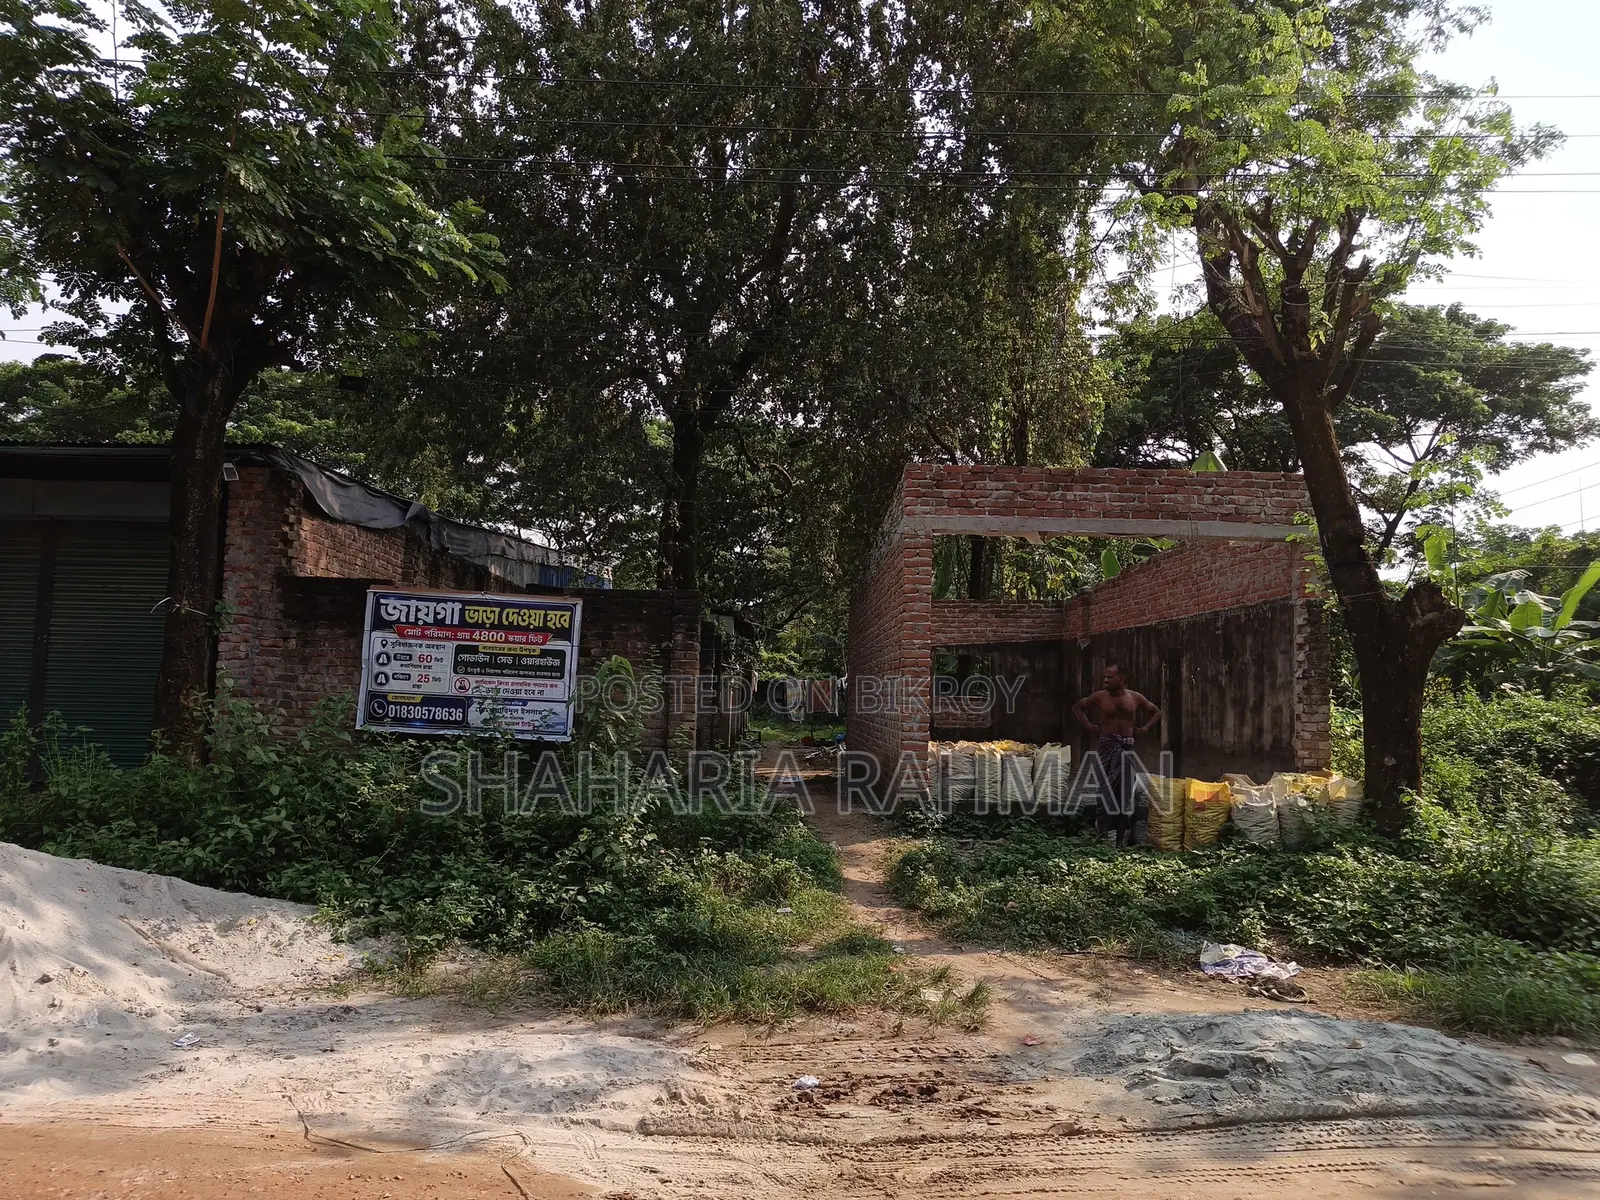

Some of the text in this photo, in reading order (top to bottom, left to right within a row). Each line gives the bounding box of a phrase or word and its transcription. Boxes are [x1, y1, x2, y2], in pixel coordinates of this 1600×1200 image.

[379, 598, 572, 630] জায়গা ভাড়া দেওয়া হবে
[404, 628, 421, 636] মোট
[424, 629, 455, 639] পরিমাণ:
[456, 631, 471, 640] প্রায়
[472, 630, 505, 642] 4800
[528, 634, 543, 644] ফিট
[390, 640, 423, 649] সুবিধাজনক
[418, 653, 432, 663] 60
[457, 653, 561, 667] গোডাউন সেড ওয়ারহাউজ
[417, 673, 430, 683] 25
[503, 688, 522, 696] দেওয়া
[523, 688, 535, 696] হবে
[388, 705, 463, 721] 01830578636
